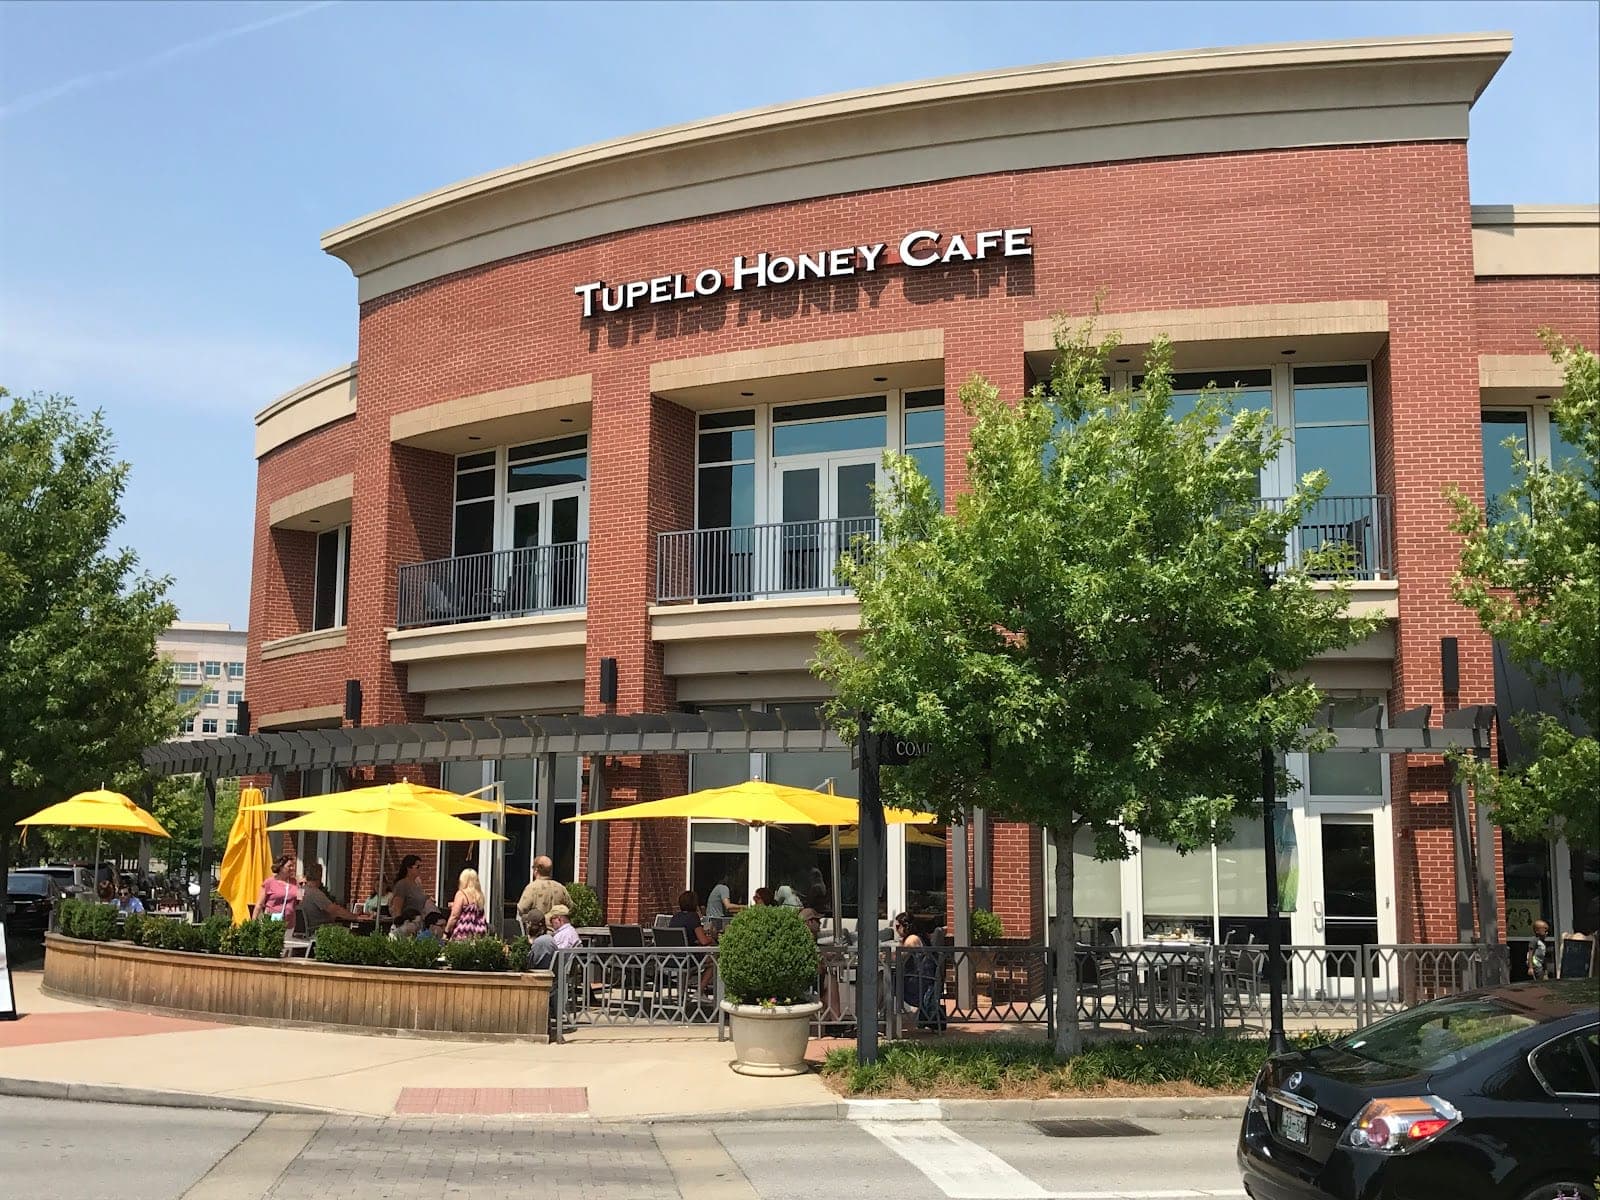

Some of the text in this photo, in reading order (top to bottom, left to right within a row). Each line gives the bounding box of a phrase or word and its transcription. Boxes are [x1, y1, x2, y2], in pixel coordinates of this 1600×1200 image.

[574, 226, 1033, 318] TUPELO HONEY CAFE
